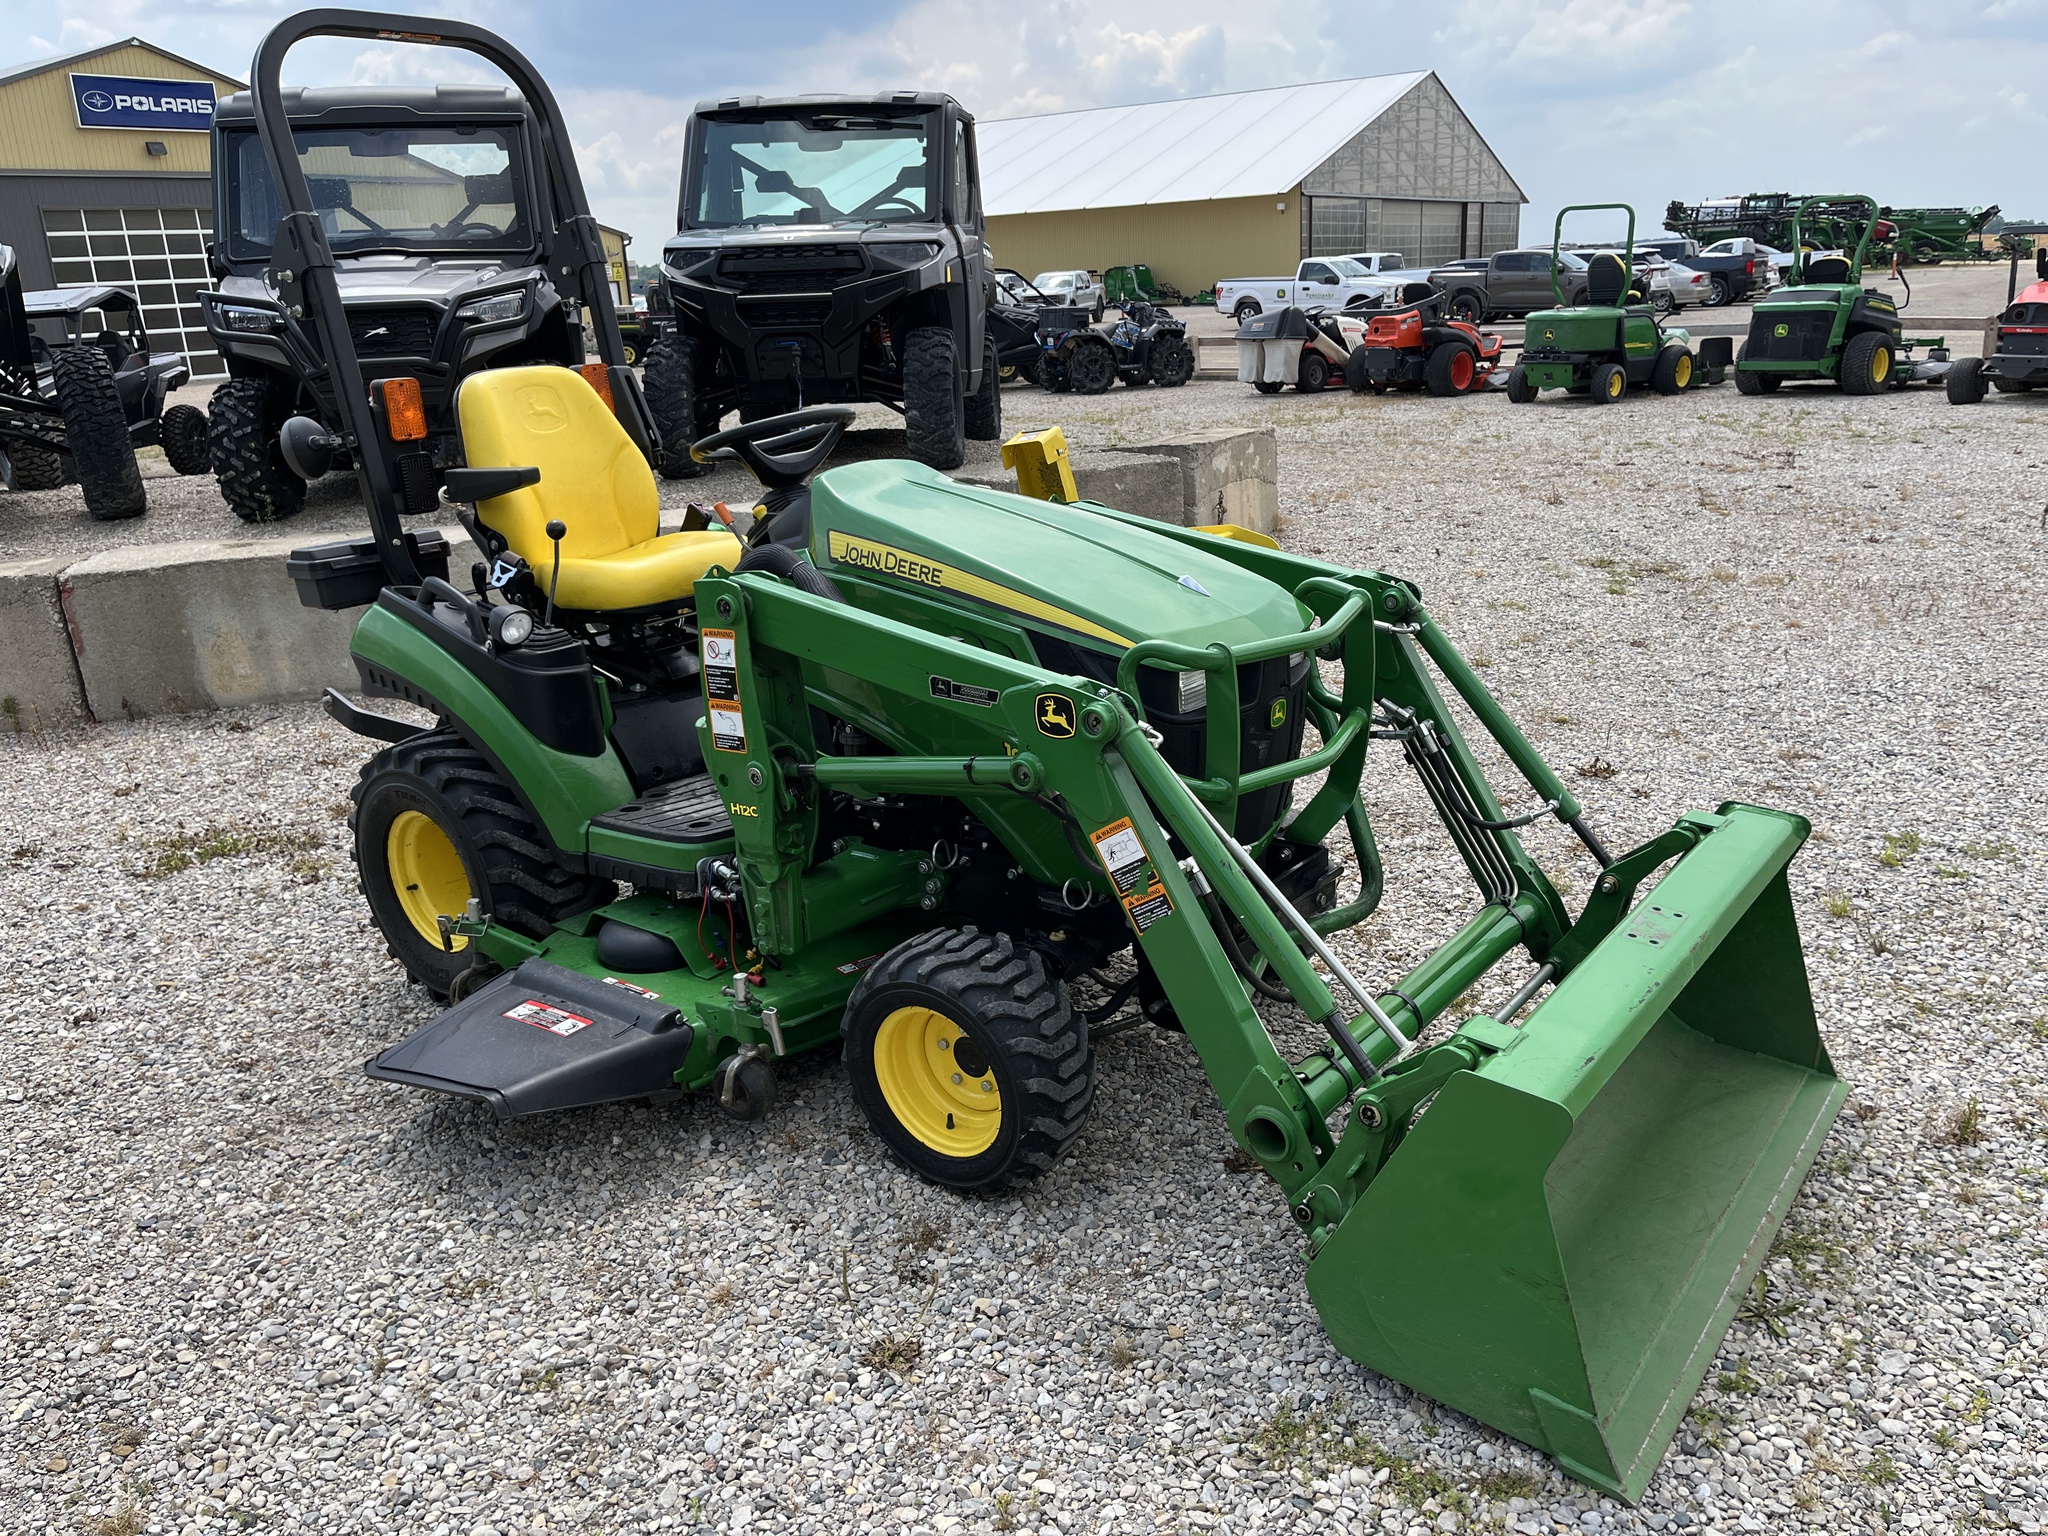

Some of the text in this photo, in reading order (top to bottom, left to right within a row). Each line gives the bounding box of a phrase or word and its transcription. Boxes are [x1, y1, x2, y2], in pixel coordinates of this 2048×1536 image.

[114, 94, 213, 114] POLARIS
[840, 542, 943, 585] JOHN DEERE
[709, 630, 734, 639] WARNING
[714, 702, 740, 712] WARNING
[730, 802, 759, 817] H12C
[1100, 821, 1127, 837] WARNING
